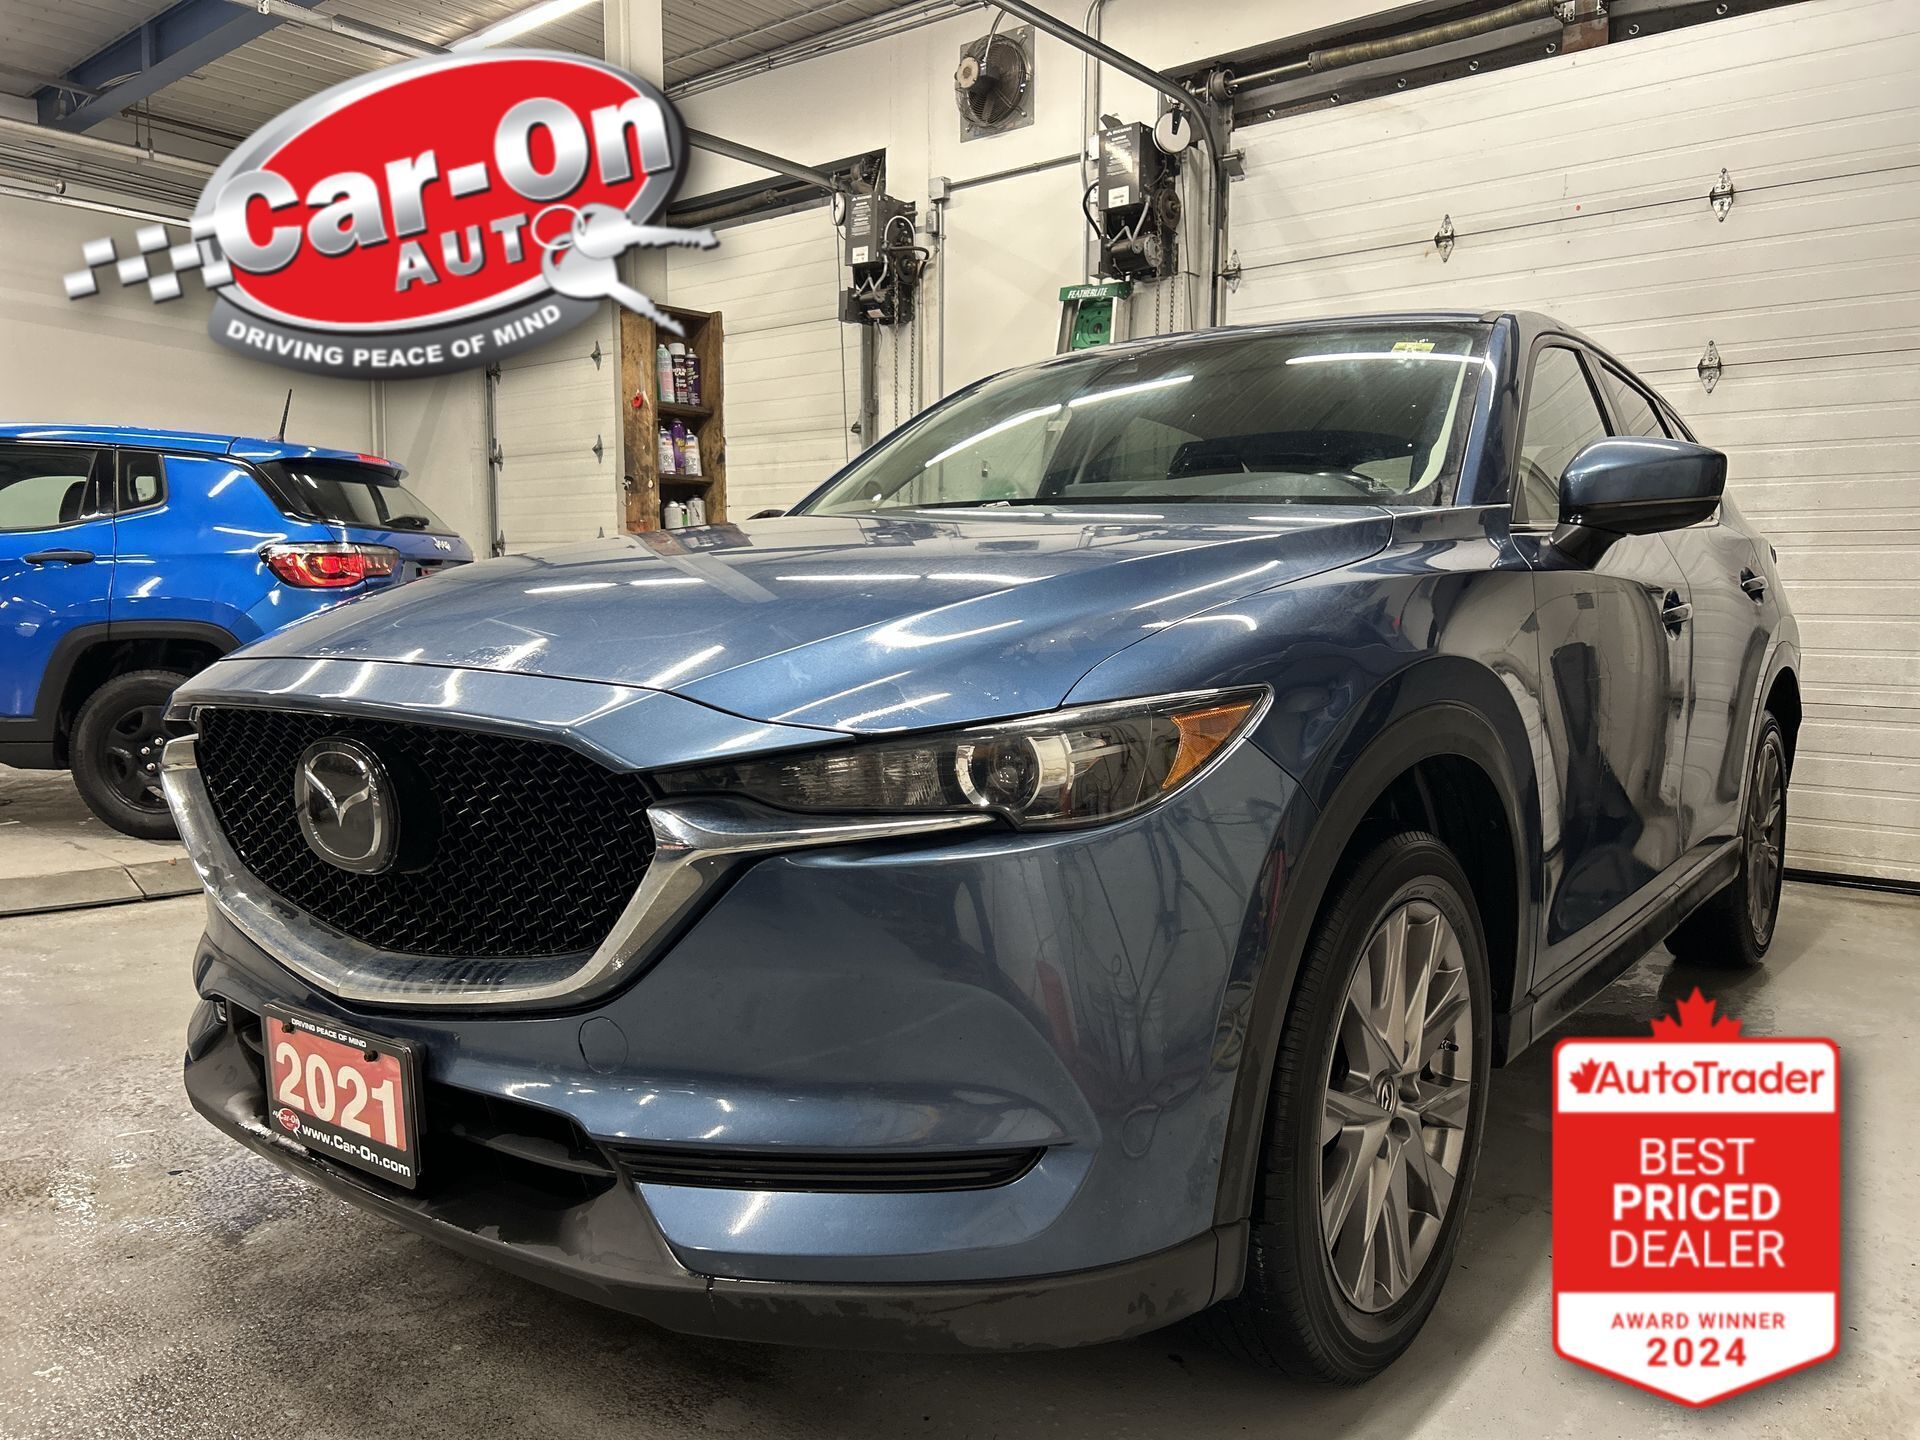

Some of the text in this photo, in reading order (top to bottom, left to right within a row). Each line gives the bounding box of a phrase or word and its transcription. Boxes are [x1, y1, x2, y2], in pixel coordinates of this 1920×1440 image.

[1067, 287, 1108, 299] FEATHERLITE
[291, 1018, 367, 1048] DRIVING PEACE OF MIND
[275, 1041, 398, 1149] 2021
[301, 1124, 411, 1178] www.Car-On.com
